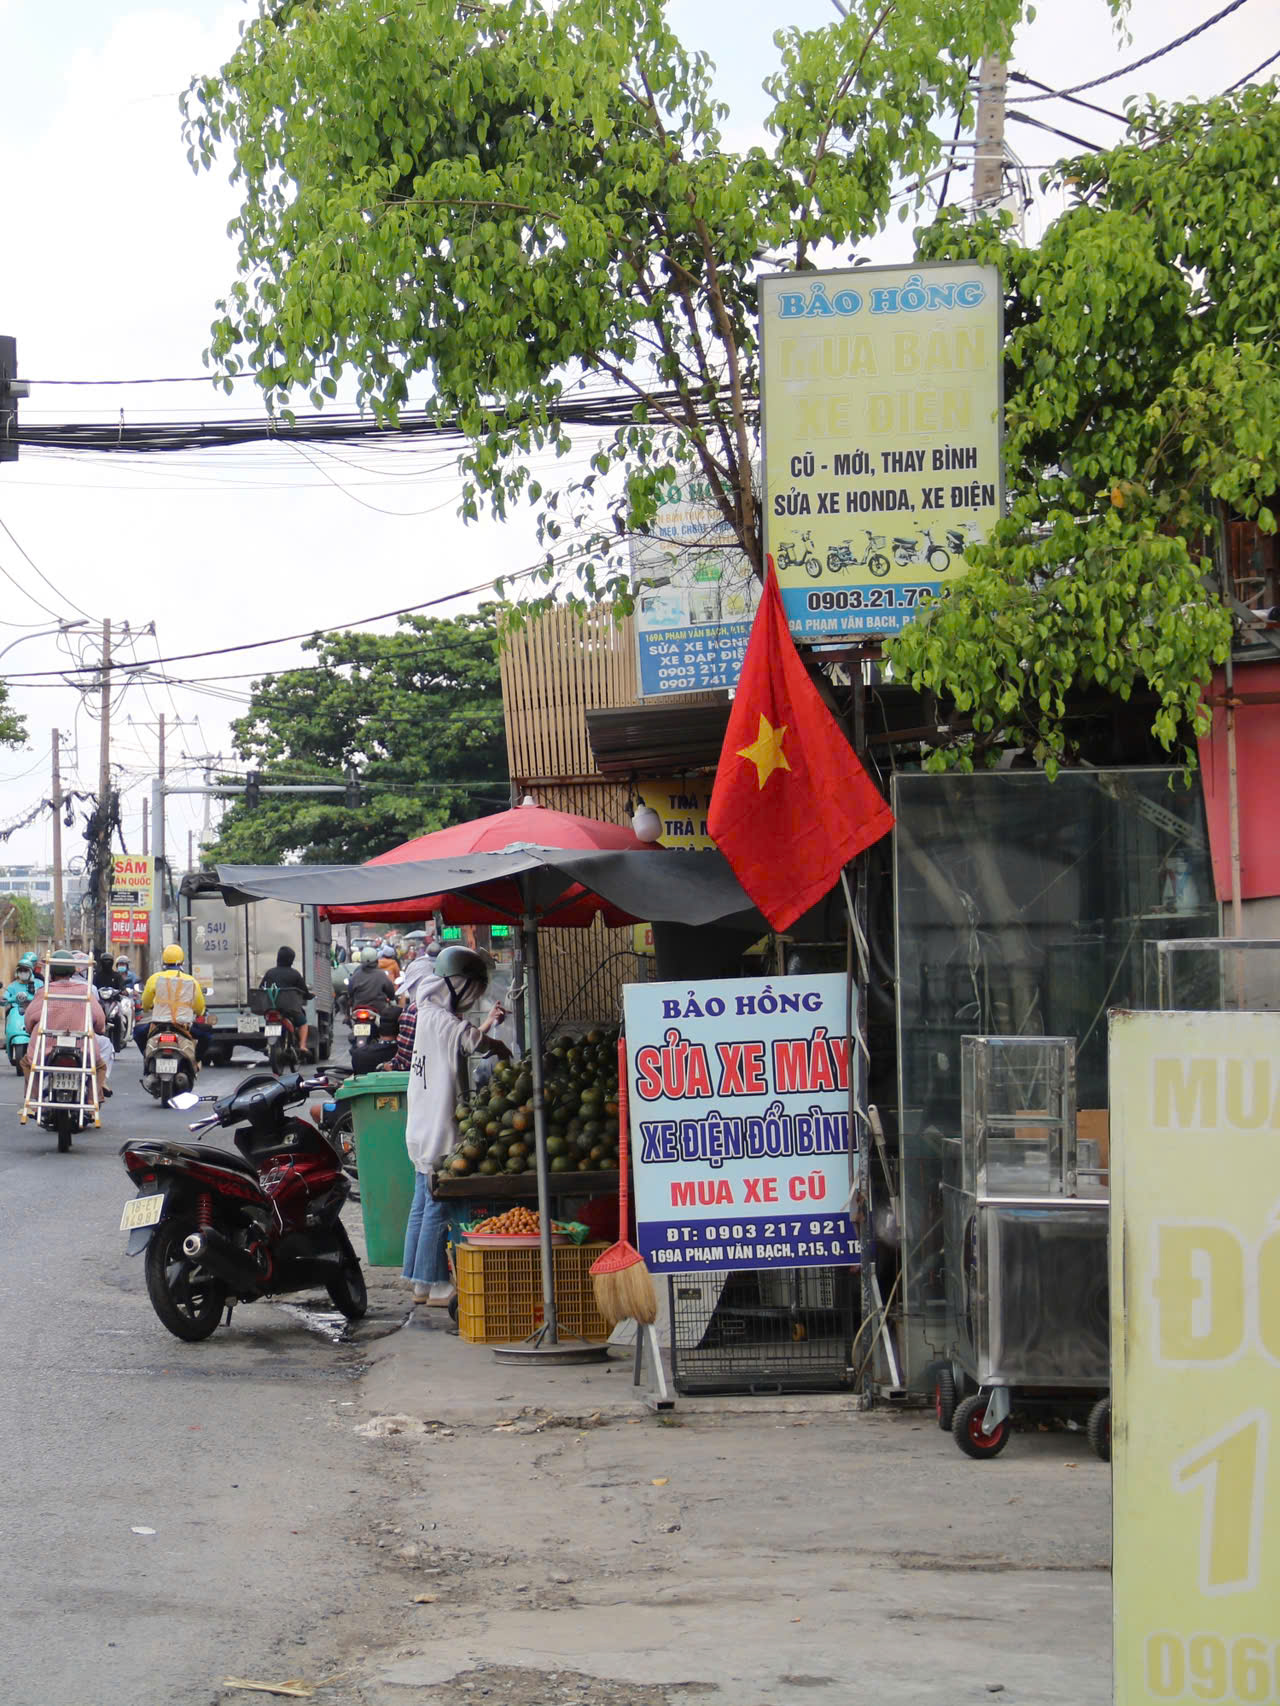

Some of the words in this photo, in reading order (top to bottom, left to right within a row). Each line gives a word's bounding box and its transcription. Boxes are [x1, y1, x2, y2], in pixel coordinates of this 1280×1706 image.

[779, 282, 863, 319] BẢO
[870, 275, 985, 314] HỒNG
[779, 334, 878, 380] MUA
[795, 394, 850, 439] XE
[790, 451, 815, 478] CŨ
[834, 449, 876, 476] MỚI,
[881, 449, 926, 475] THAY
[932, 444, 977, 471] BÌNH
[774, 486, 812, 516] SỬA
[816, 492, 840, 514] XE
[846, 489, 915, 513] HONDA,
[921, 487, 945, 510] XE
[951, 480, 995, 512] ĐIỆN
[645, 633, 664, 643] 169A
[805, 616, 841, 633] PHẠM
[840, 614, 864, 631] VĂN
[866, 614, 900, 632] BẠCH,
[648, 641, 680, 655] SỬA
[684, 641, 704, 652] XE
[660, 655, 680, 666] XE
[683, 652, 716, 665] ĐẠP
[721, 647, 746, 661] ĐIỆ
[658, 666, 695, 678] 0903
[700, 663, 728, 674] 217
[660, 678, 696, 689] 0907
[701, 675, 727, 686] 741
[664, 818, 696, 836] TRÀ
[115, 858, 148, 874] SÂM
[204, 940, 229, 951] 2512
[662, 990, 726, 1019] BẢO
[735, 984, 823, 1016] HỒNG
[636, 1028, 714, 1101] SỬA
[717, 1040, 766, 1097] XE
[772, 1026, 856, 1094] MÁY
[1151, 1055, 1280, 1130] MU
[640, 1119, 678, 1164] XE
[679, 1110, 745, 1168] ĐIỆN
[744, 1100, 793, 1159] ĐỔI
[796, 1105, 859, 1156] BÌNH
[670, 1179, 735, 1207] MUA
[743, 1177, 779, 1205] XE
[788, 1170, 826, 1201] CŨ
[666, 1226, 699, 1242] ĐT:
[705, 1223, 757, 1240] 0903
[764, 1221, 802, 1237] 217
[809, 1220, 846, 1235] 921
[650, 1248, 683, 1263] 169A
[685, 1246, 724, 1265] PHẠM
[726, 1243, 754, 1261] VĂN
[756, 1244, 795, 1261] BẠCH,
[798, 1241, 828, 1257] P.15,
[831, 1240, 844, 1256] Q.
[1145, 1632, 1280, 1704] 096
